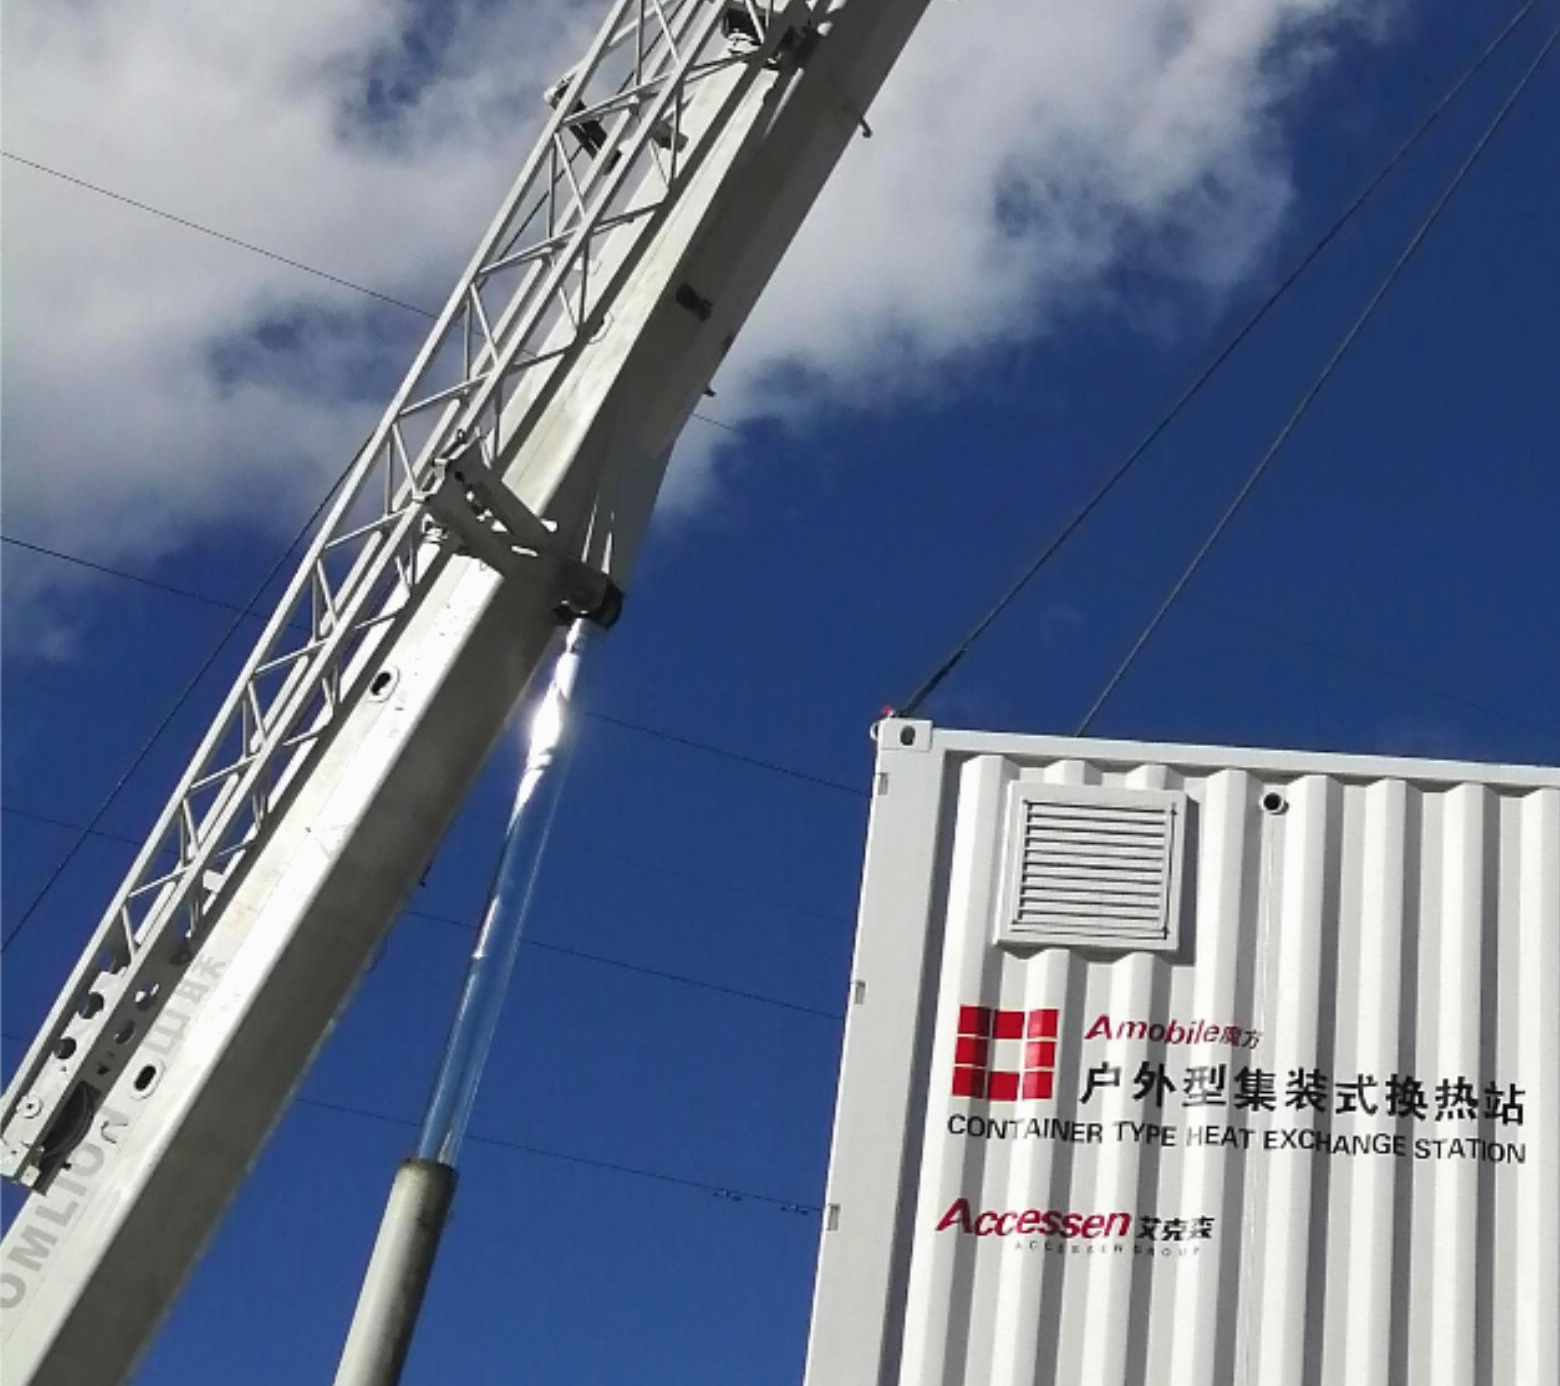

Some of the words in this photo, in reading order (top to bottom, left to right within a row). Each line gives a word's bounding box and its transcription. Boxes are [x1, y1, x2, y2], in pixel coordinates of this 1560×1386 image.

[1084, 1014, 1220, 1046] Amobile
[1078, 1060, 1527, 1126] 户外型集装式换热站
[947, 1113, 1104, 1144] CONTAINER
[1115, 1120, 1178, 1147] TYPE
[1186, 1124, 1256, 1150] HEAT
[1262, 1127, 1407, 1157] EXCHANGE
[1414, 1137, 1527, 1164] STATION
[935, 1197, 1133, 1240] Accessen
[1135, 1215, 1216, 1242] 艾克森
